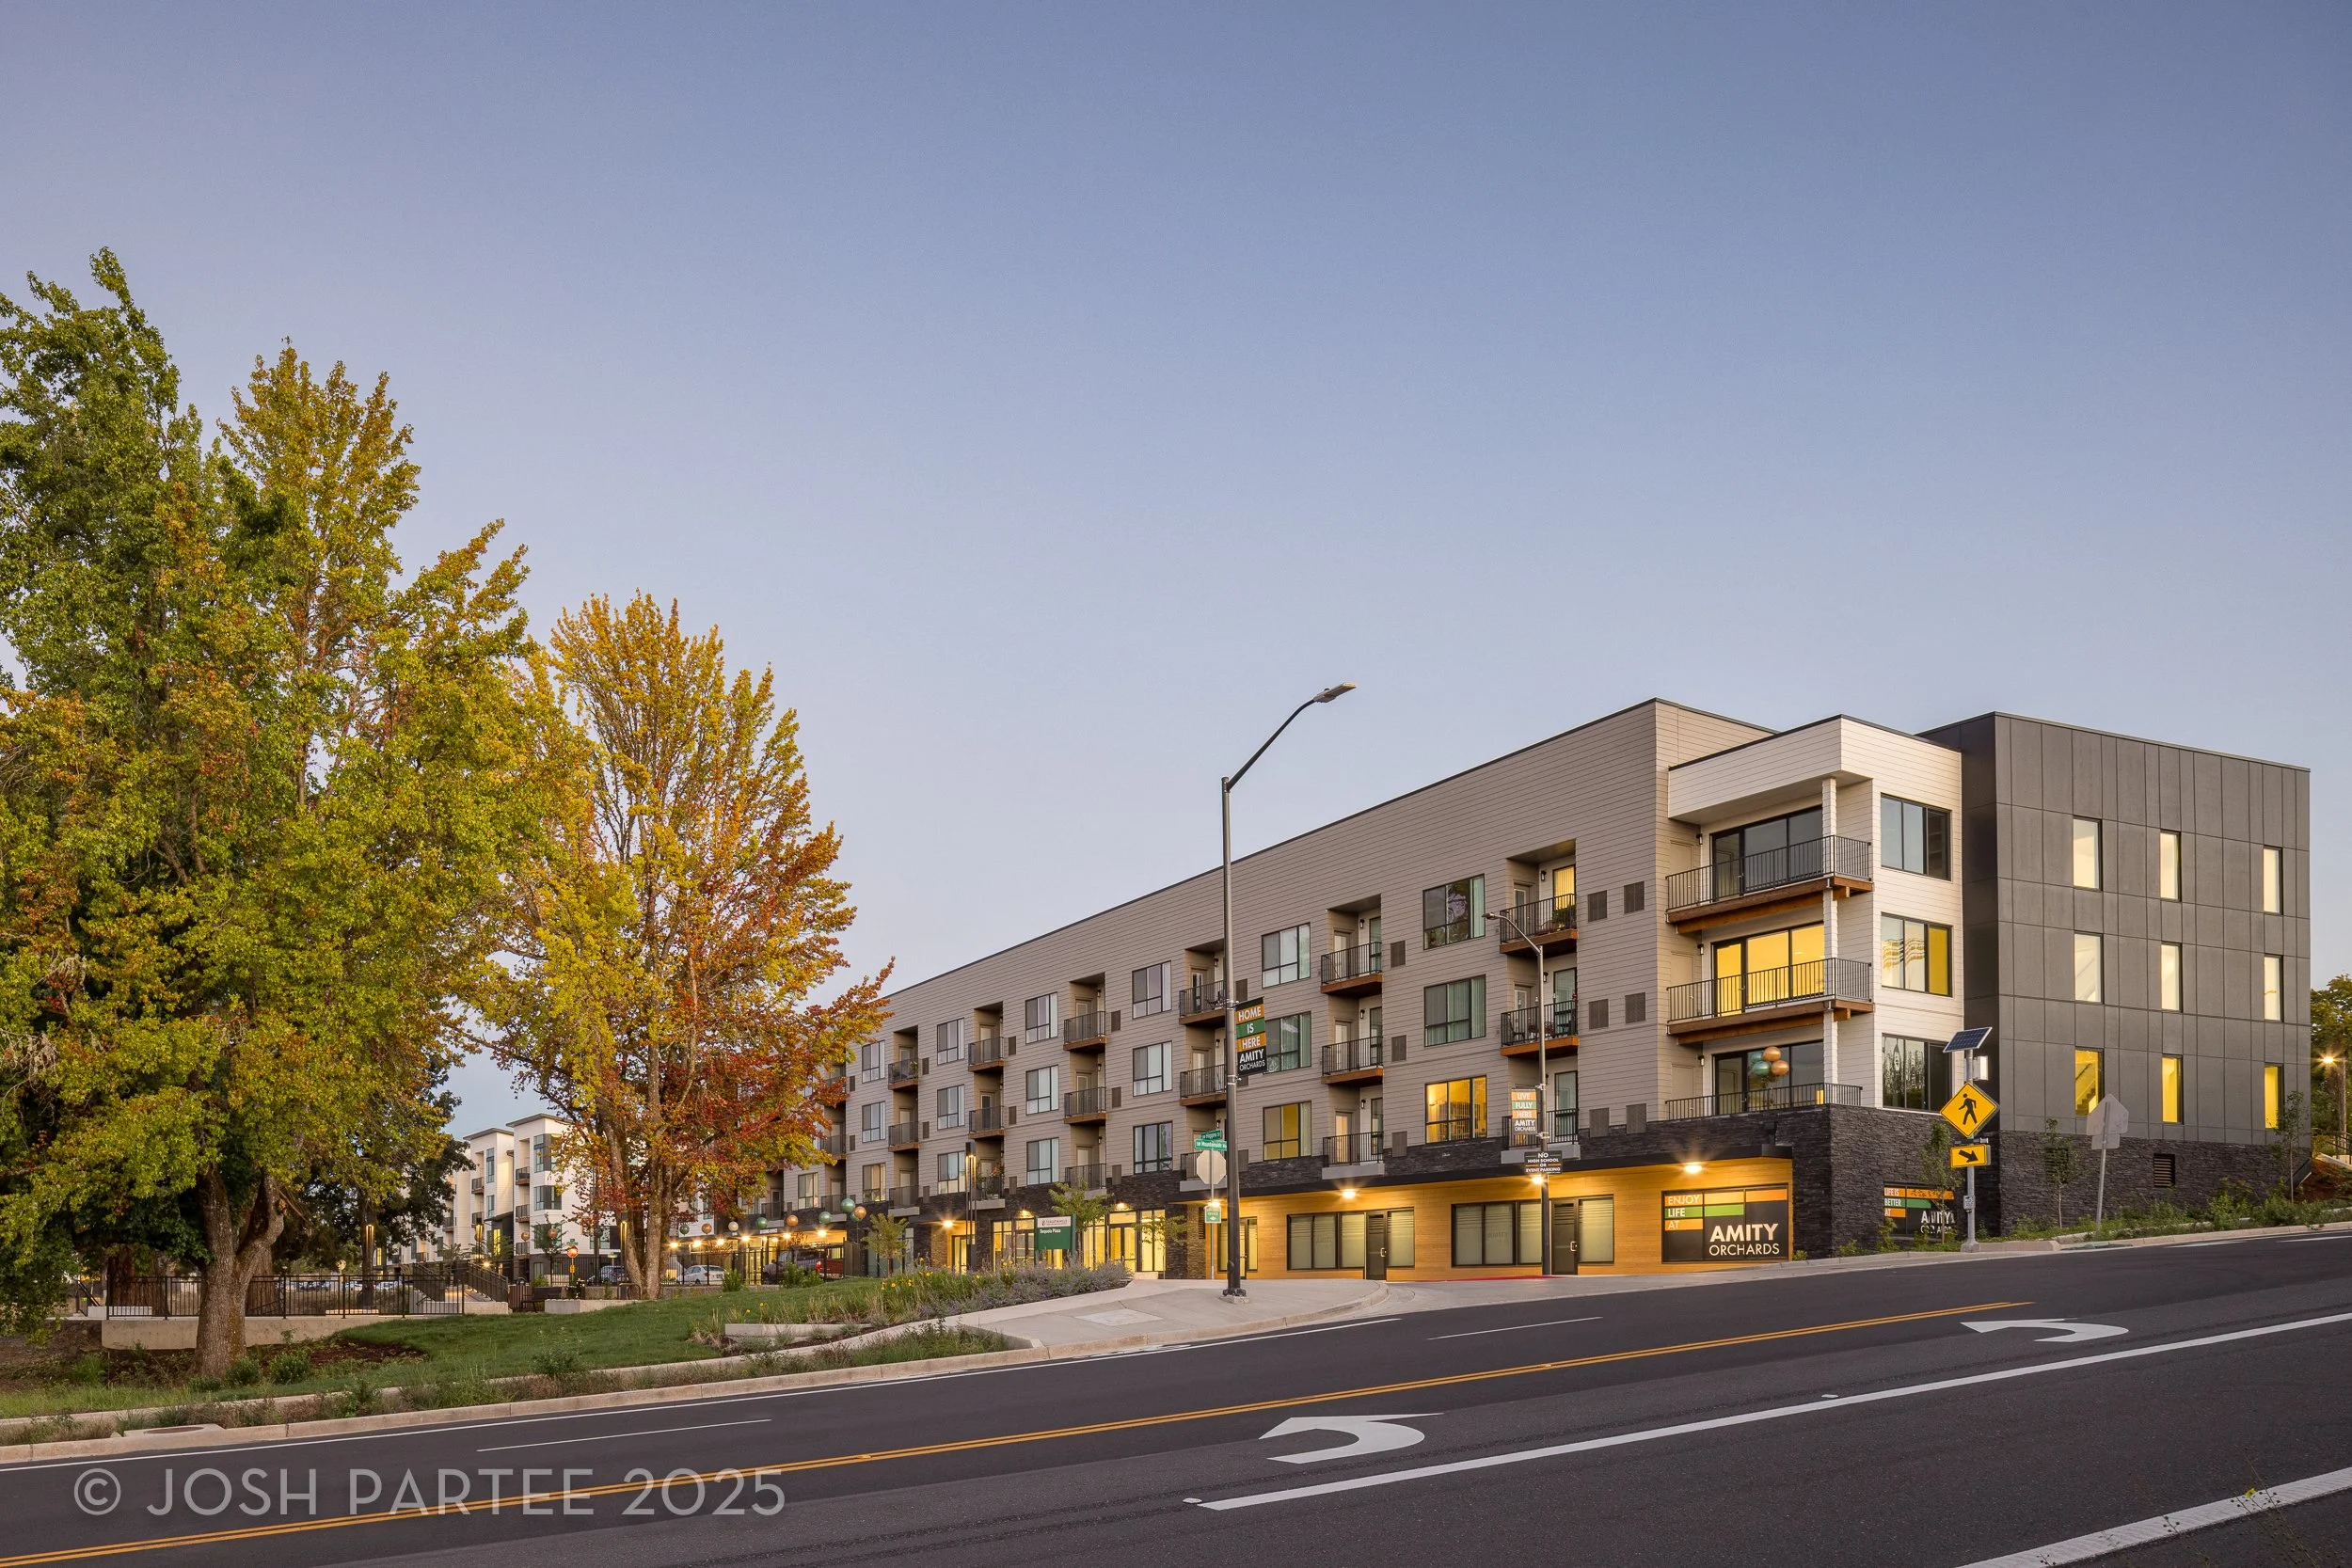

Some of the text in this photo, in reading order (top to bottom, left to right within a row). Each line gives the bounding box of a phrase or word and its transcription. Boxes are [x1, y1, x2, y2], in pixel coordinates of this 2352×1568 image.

[1238, 1006, 1261, 1022] HOME
[1247, 1022, 1254, 1034] IS
[1242, 1037, 1261, 1049] HERE
[1239, 1049, 1264, 1063] AMITY
[1239, 1060, 1265, 1070] ORCHARDS
[1884, 1187, 1899, 1196] LIFE IS
[1668, 1195, 1699, 1204] ENJOY
[1884, 1198, 1902, 1206] BETTER
[1667, 1208, 1686, 1217] LIFE
[1884, 1208, 1892, 1217] AT
[1667, 1220, 1680, 1229] AT
[1709, 1223, 1779, 1243] AMITY
[1708, 1243, 1780, 1257] ORCHARDS
